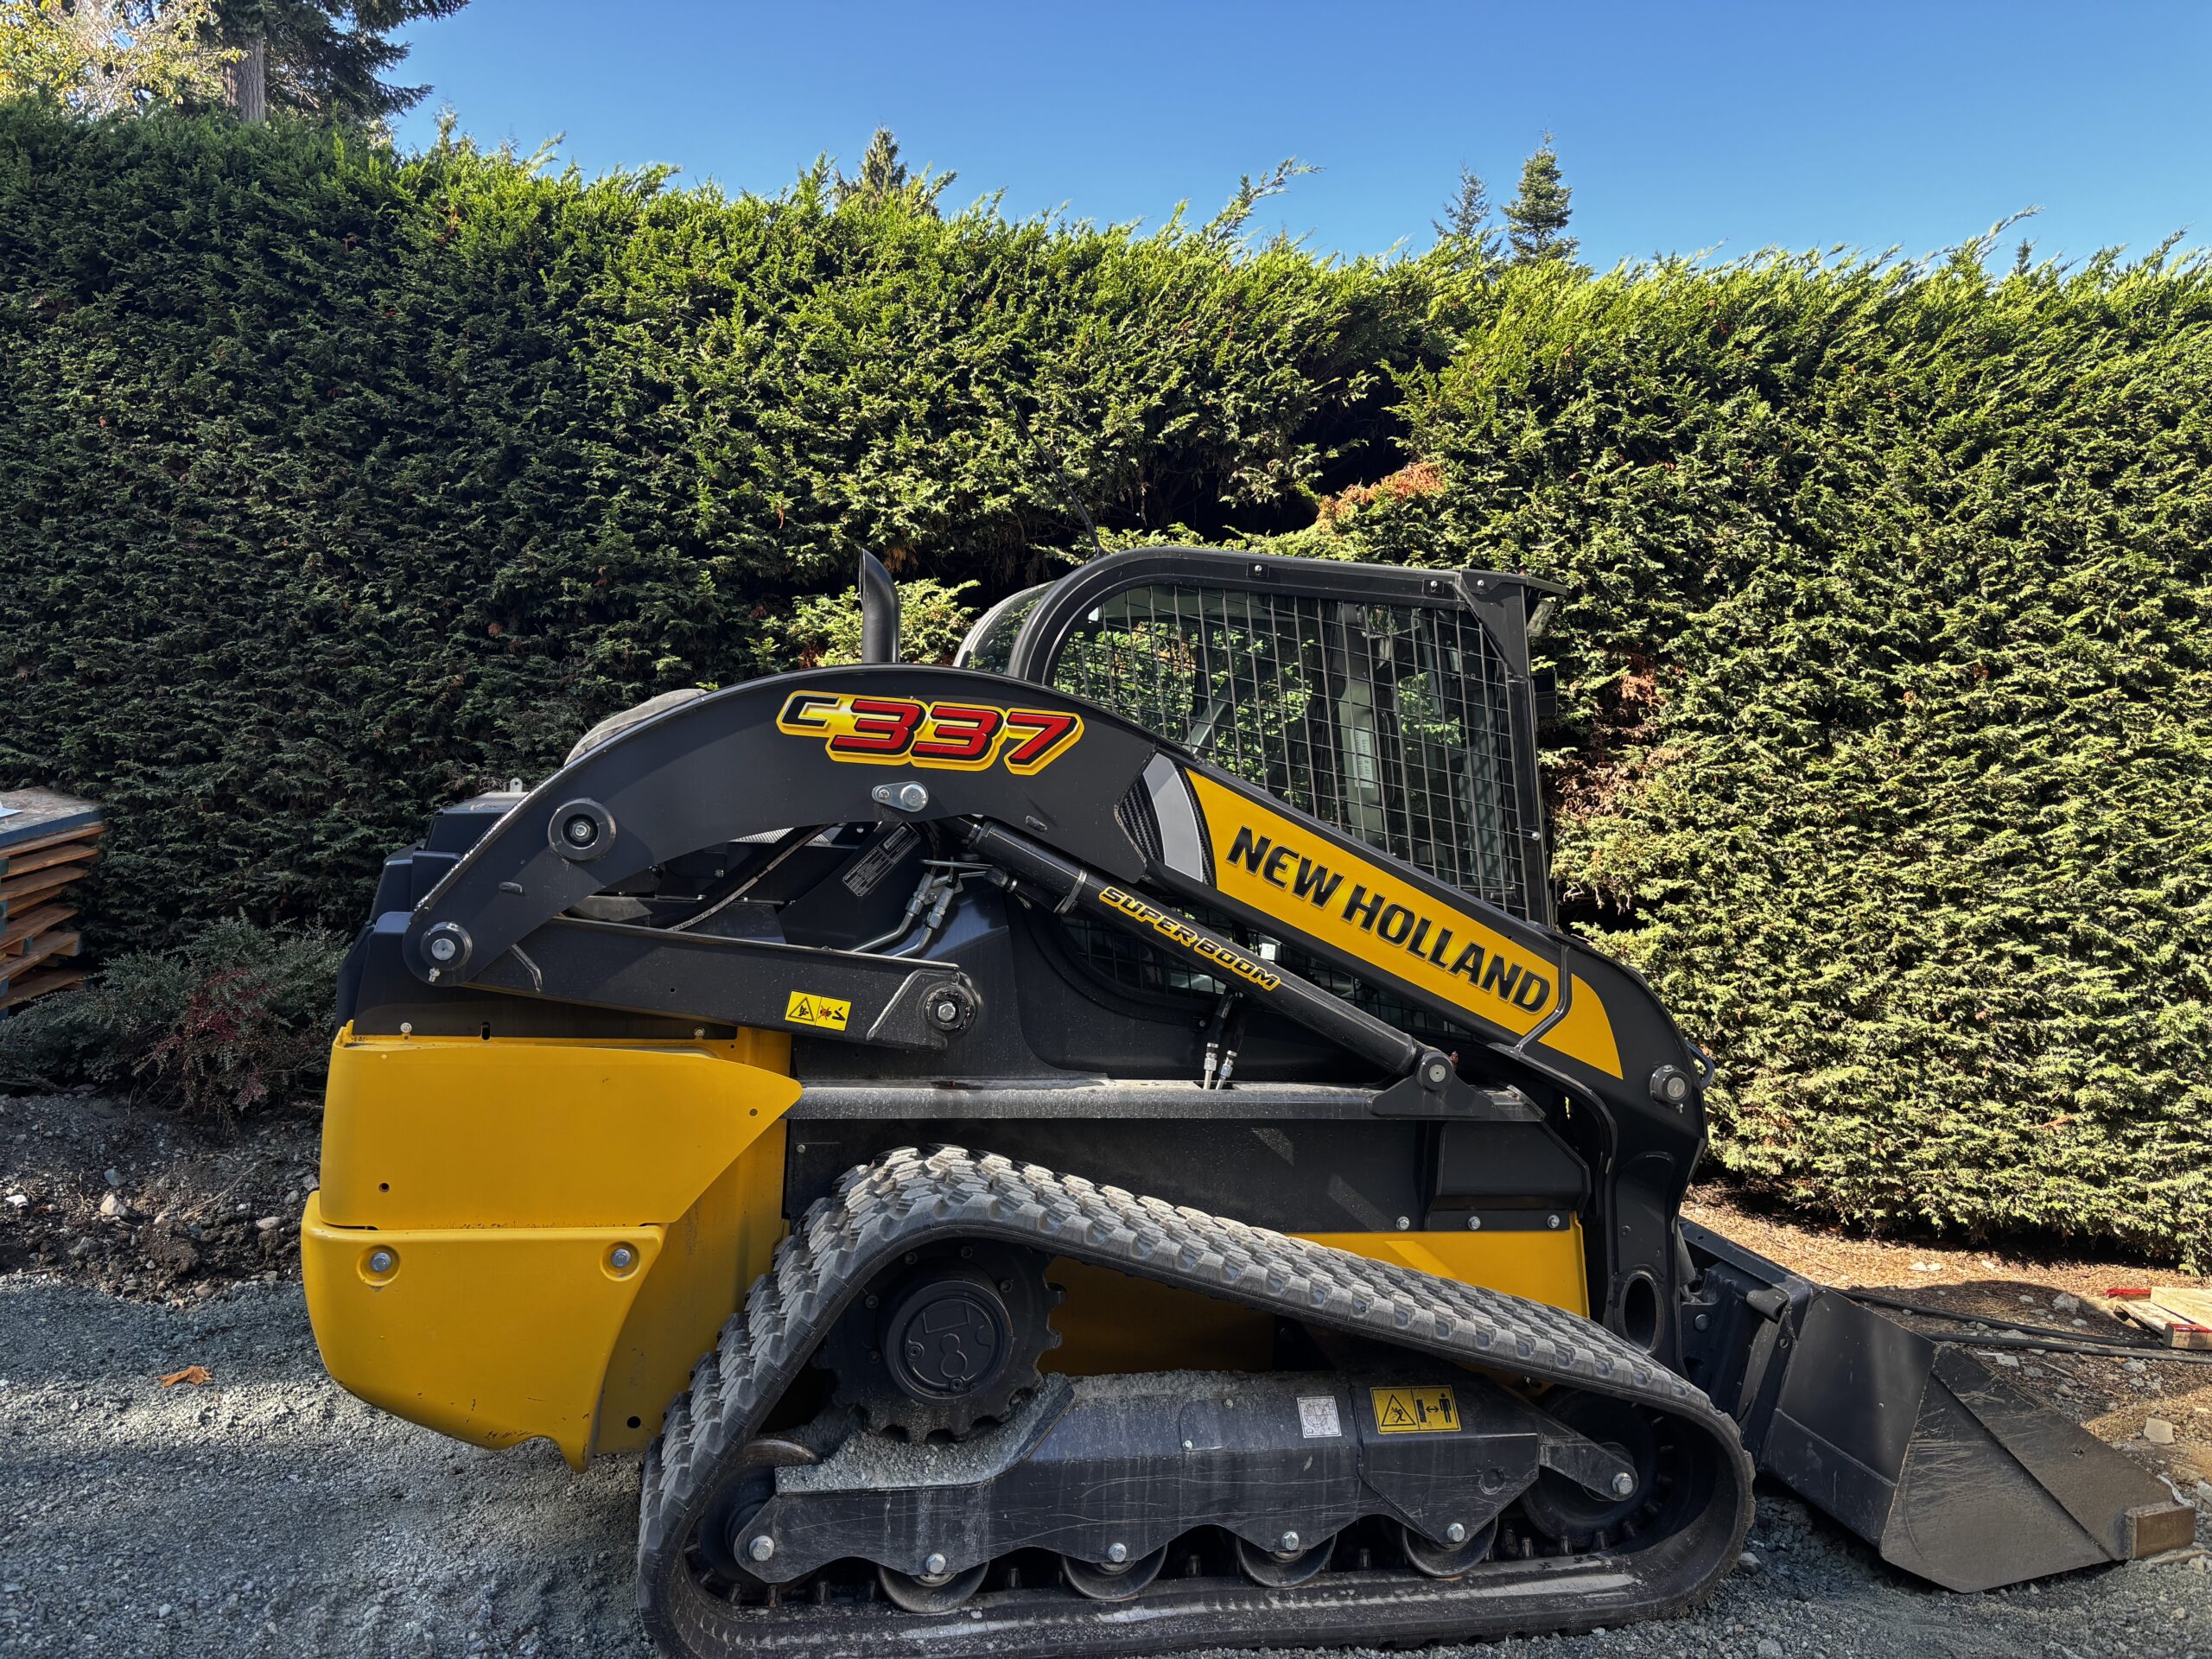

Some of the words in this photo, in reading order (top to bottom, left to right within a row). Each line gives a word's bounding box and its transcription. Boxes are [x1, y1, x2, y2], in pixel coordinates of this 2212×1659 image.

[1099, 886, 1198, 947] SUPER
[1194, 938, 1281, 991] BOOM
[1225, 825, 1344, 909] NEW
[1340, 884, 1551, 1014] HOLLAND
